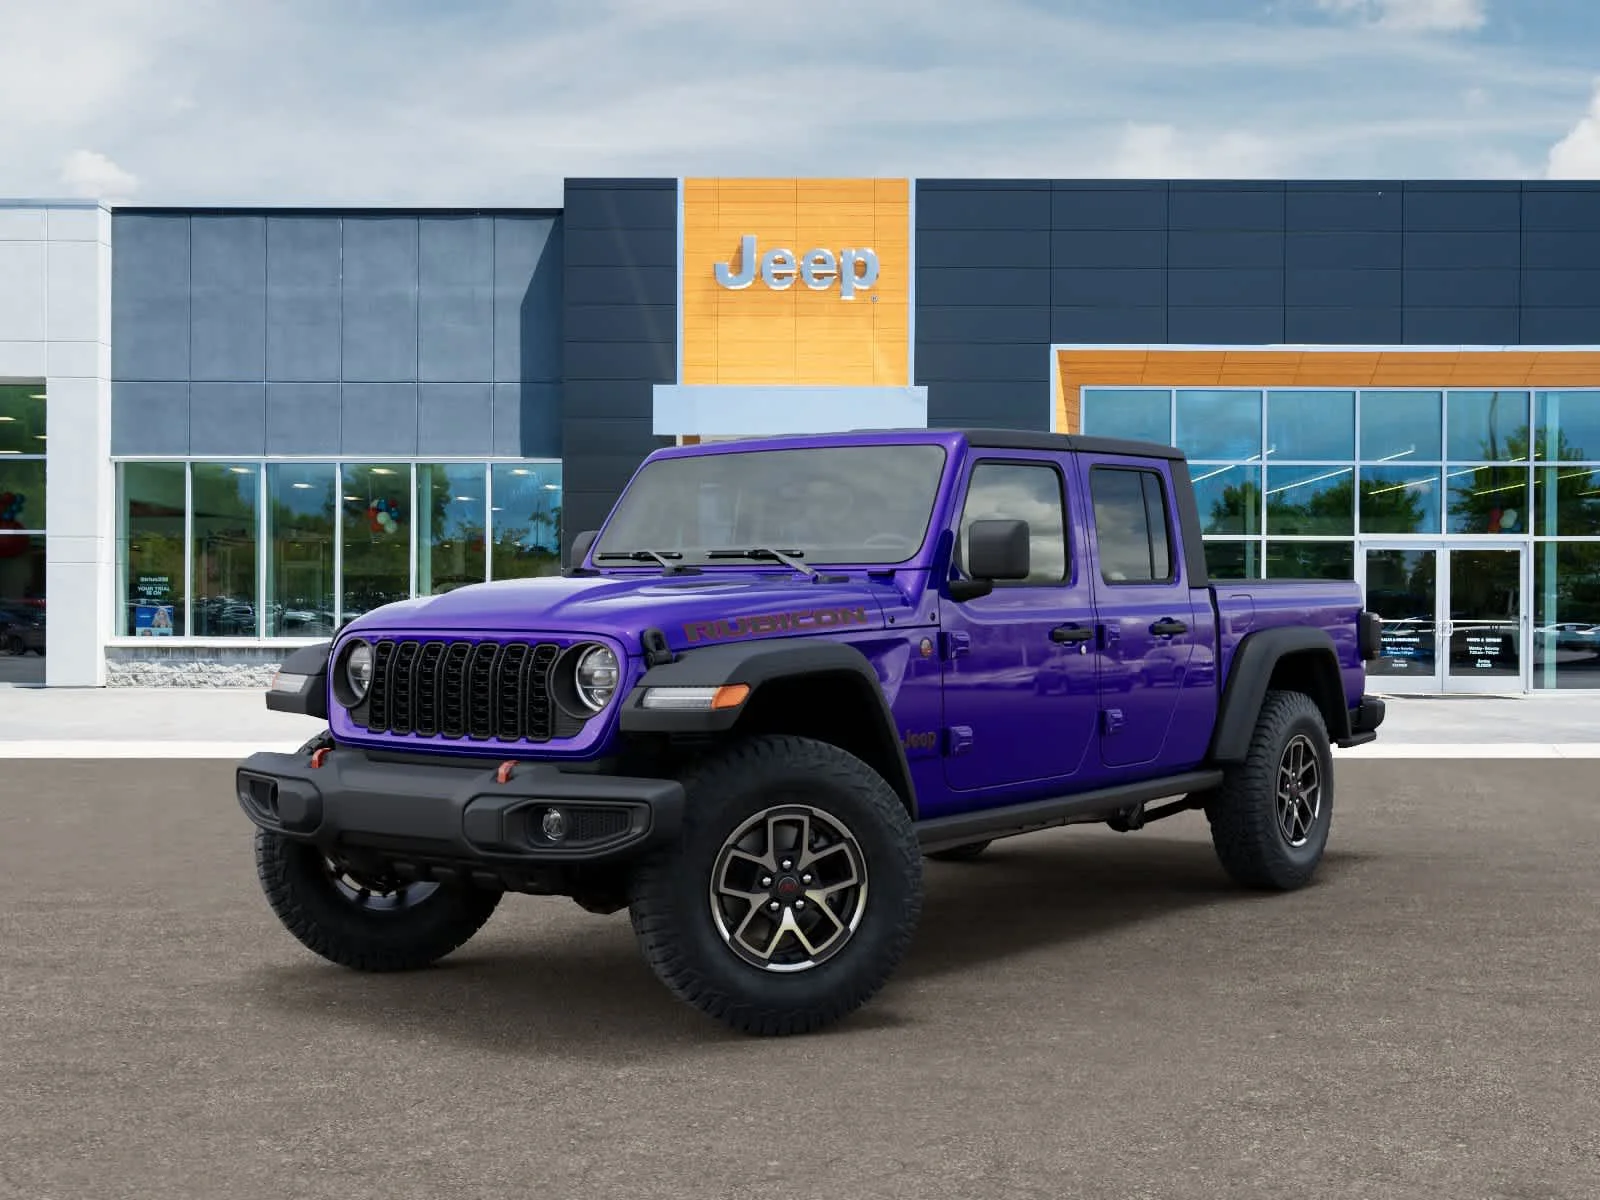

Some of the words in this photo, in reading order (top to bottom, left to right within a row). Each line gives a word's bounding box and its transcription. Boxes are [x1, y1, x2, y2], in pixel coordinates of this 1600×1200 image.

[714, 234, 879, 300] Jeep
[683, 606, 868, 643] RUBICON
[900, 729, 936, 750] Jeep
